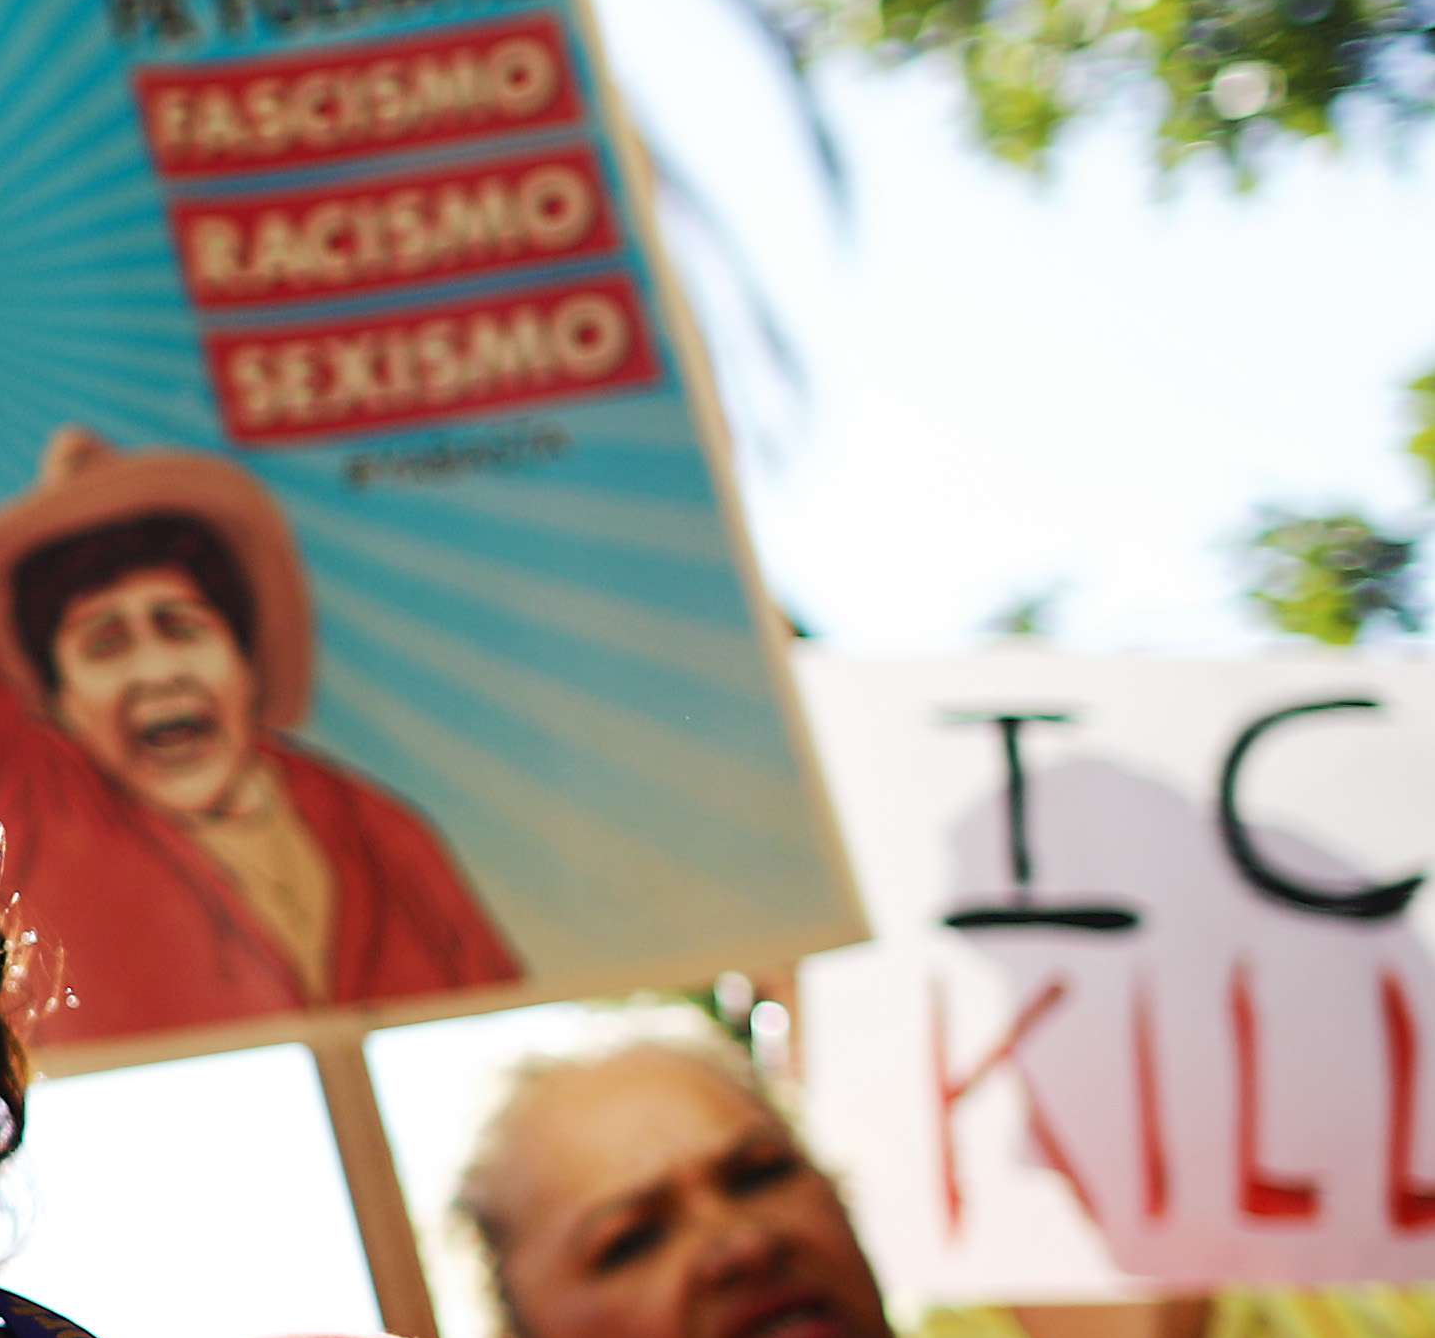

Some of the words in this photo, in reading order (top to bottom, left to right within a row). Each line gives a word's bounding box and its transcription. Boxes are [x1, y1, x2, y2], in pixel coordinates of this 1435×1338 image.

[161, 36, 559, 166] FASCISMO
[189, 164, 594, 293] RACISMO
[225, 293, 630, 426] SEXISMO
